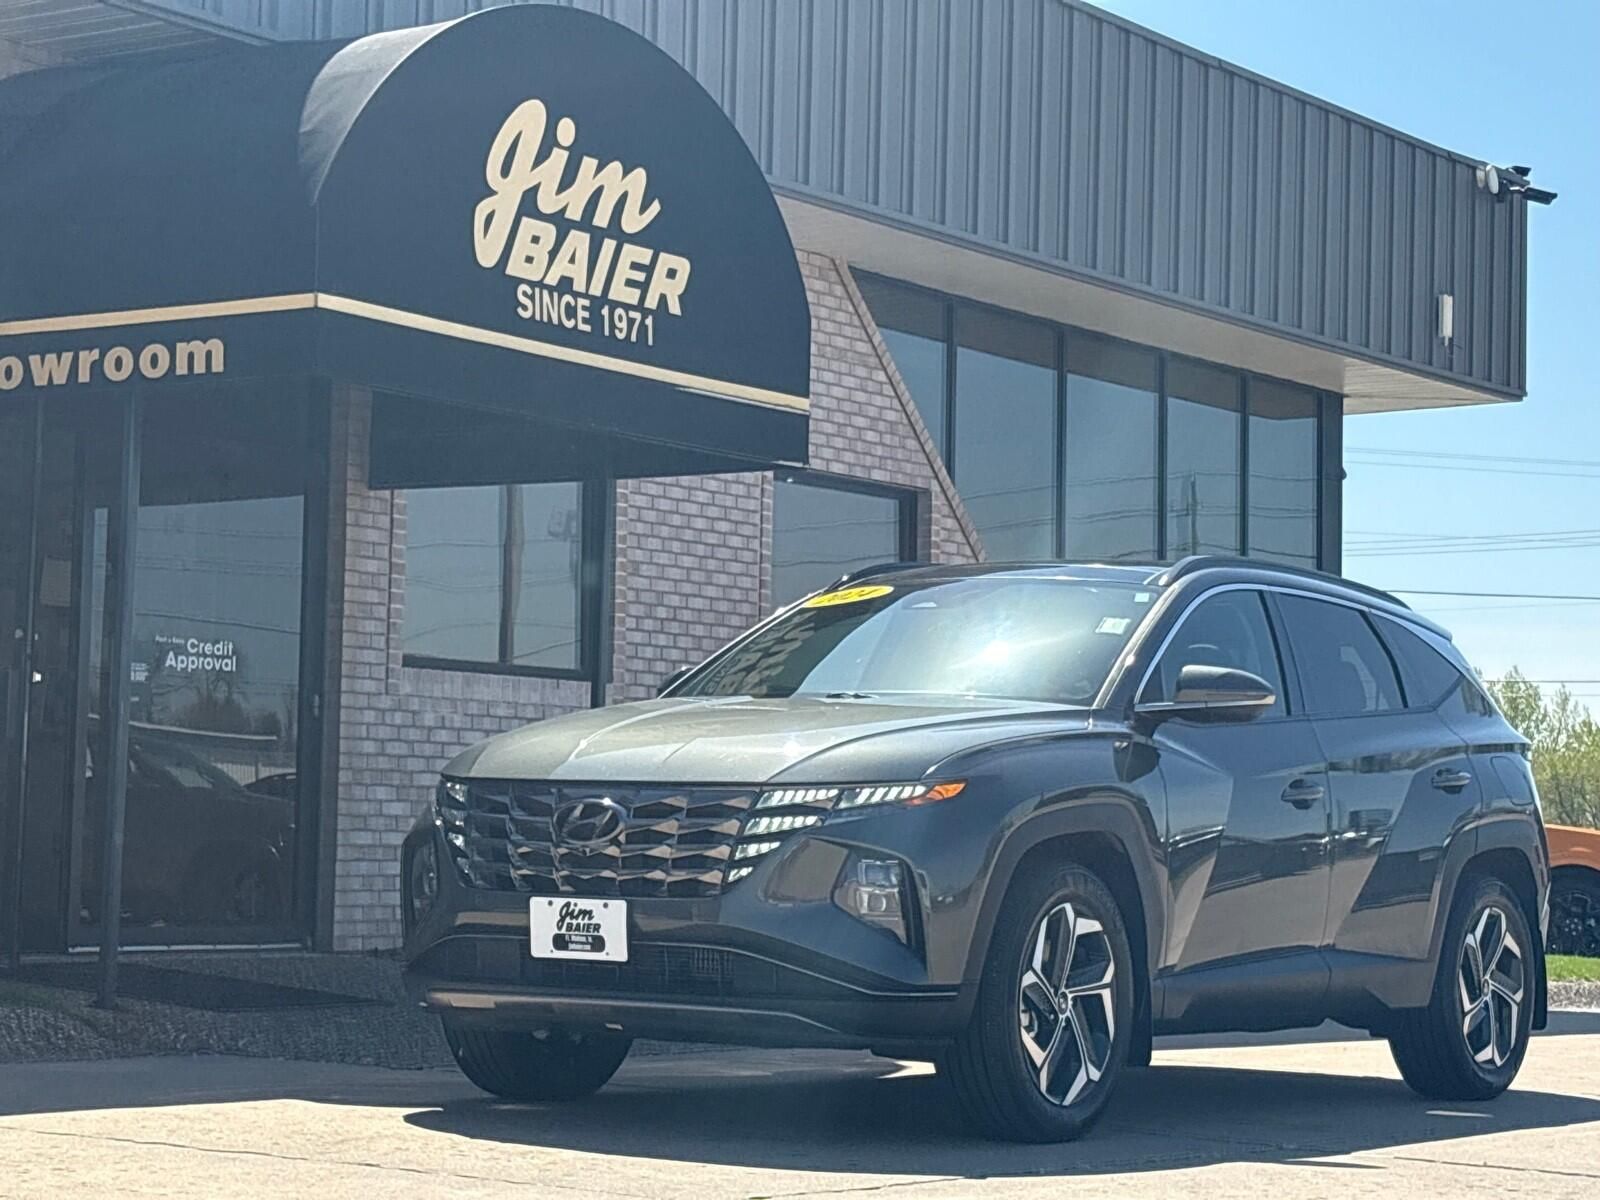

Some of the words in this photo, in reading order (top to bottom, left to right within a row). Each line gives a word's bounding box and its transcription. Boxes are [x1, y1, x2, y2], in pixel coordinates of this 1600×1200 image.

[473, 98, 662, 269] Jim
[504, 215, 692, 317] BAIER
[516, 282, 593, 333] SINCE
[600, 304, 654, 346] 1971
[0, 338, 225, 390] owroom
[165, 650, 237, 673] Approval
[186, 638, 234, 656] Credit
[556, 901, 595, 932] Jim
[565, 922, 602, 934] BAIER
